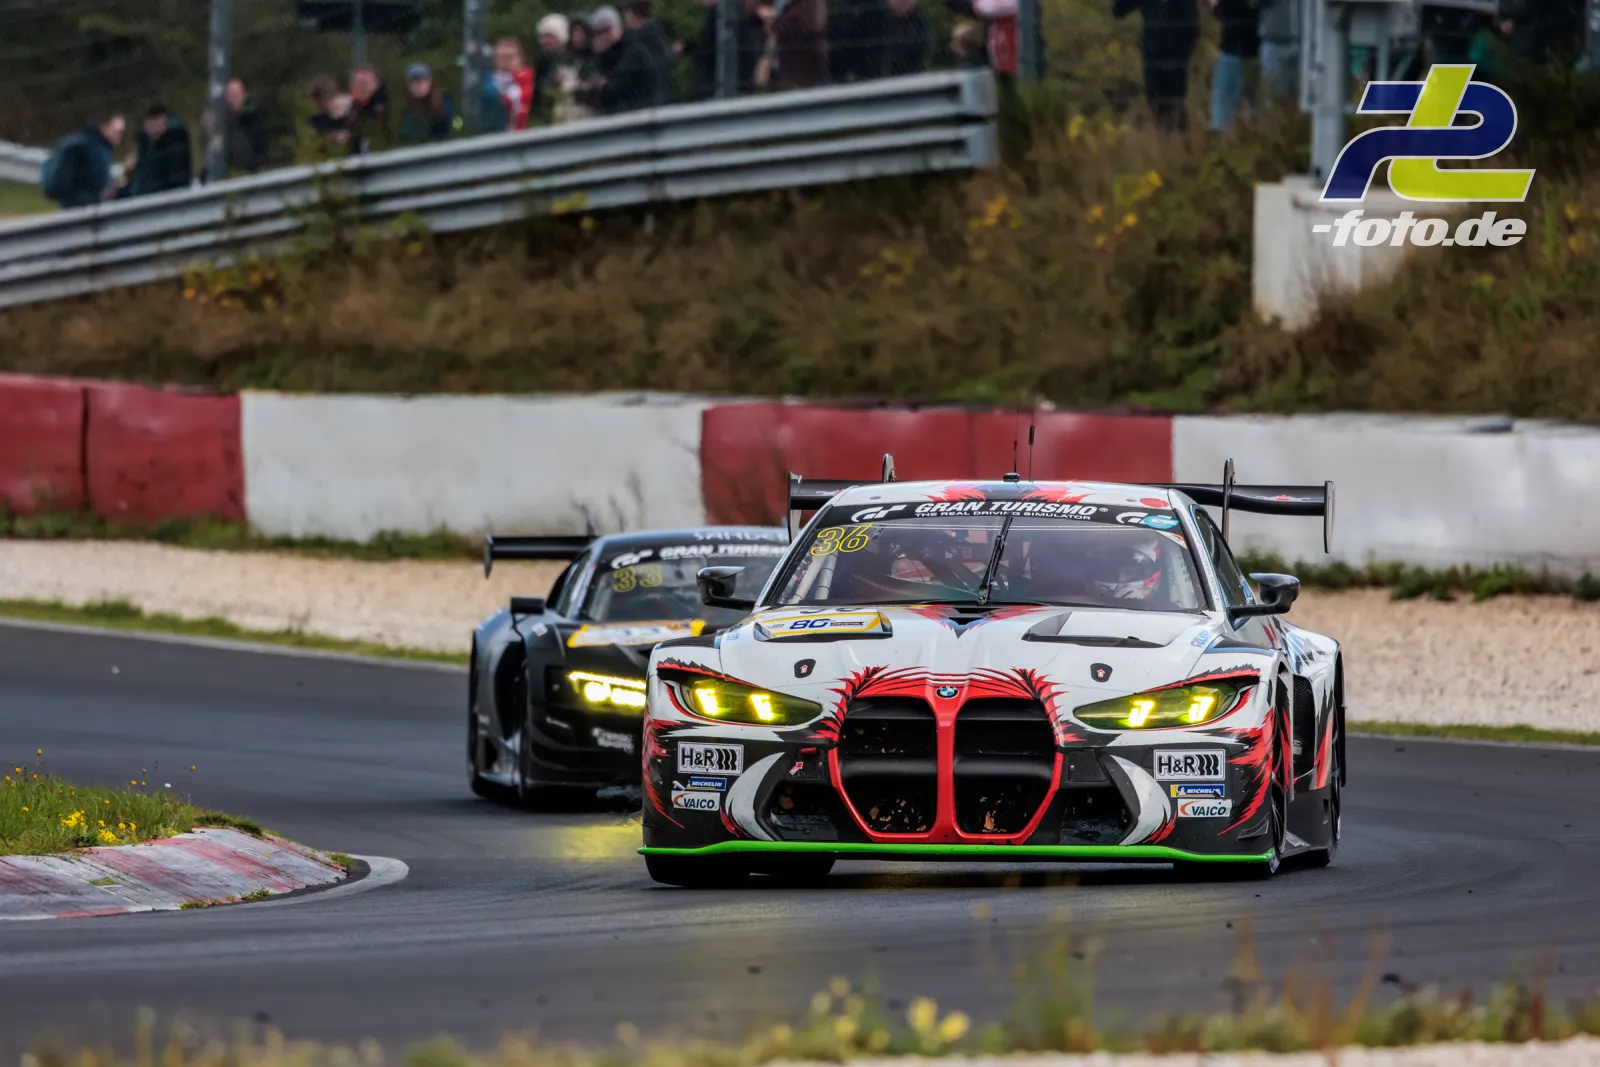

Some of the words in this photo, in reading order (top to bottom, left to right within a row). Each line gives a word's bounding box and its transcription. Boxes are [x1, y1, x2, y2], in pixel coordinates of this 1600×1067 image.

[914, 501, 986, 513] GRAN
[1023, 512, 1091, 520] SIMULATOR
[810, 524, 873, 557] 36
[659, 544, 715, 559] GRAN
[612, 563, 663, 593] 33
[681, 746, 716, 769] H&R
[1157, 754, 1197, 776] H&R
[691, 780, 723, 788] MICHELIN
[683, 798, 715, 809] VAICO
[1191, 806, 1227, 816] VAICO
